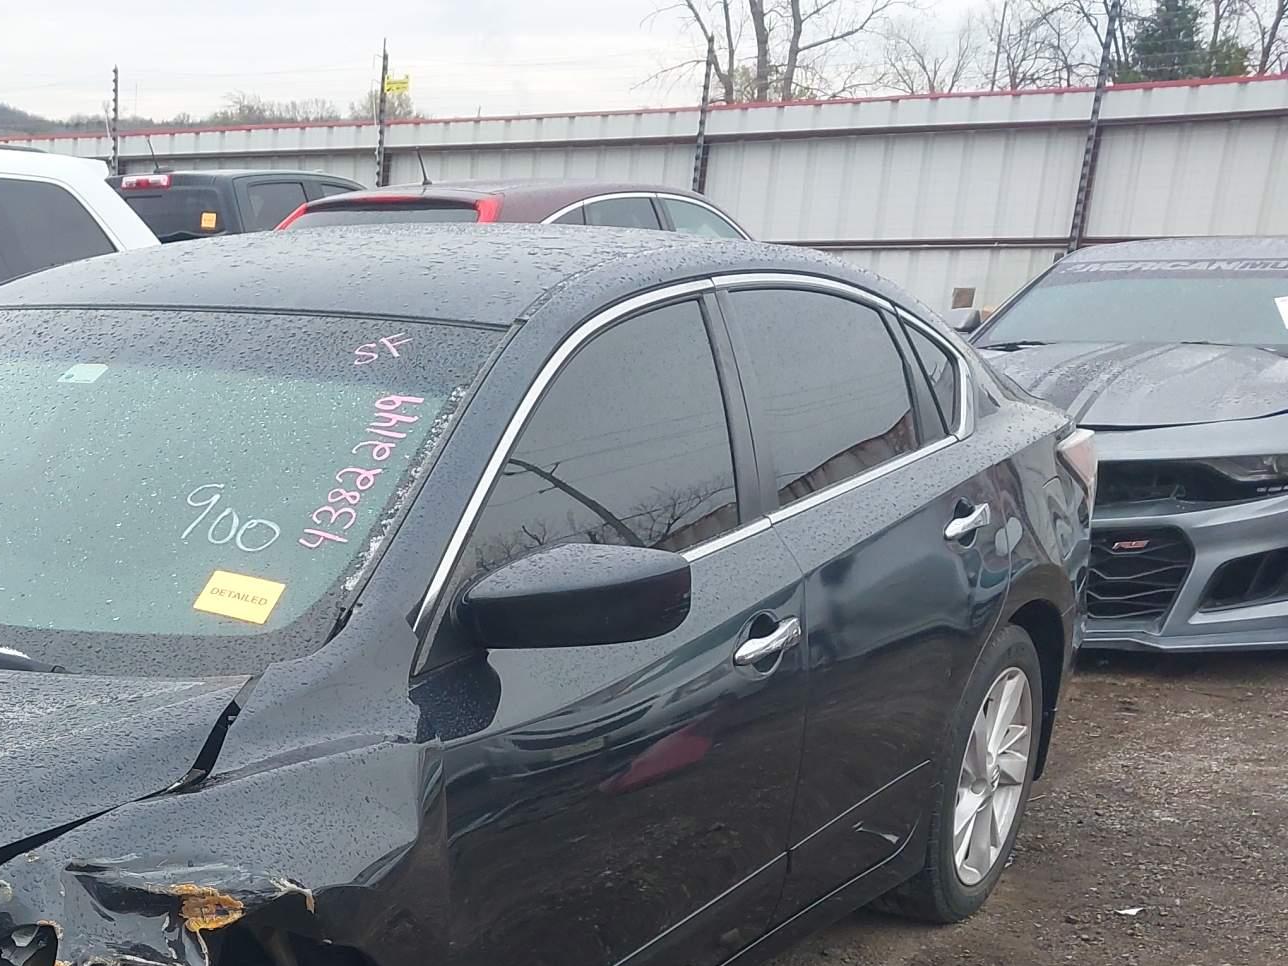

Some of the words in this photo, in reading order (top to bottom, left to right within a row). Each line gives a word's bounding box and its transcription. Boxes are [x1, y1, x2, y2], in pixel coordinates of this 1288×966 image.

[299, 394, 424, 548] 43822149
[181, 482, 281, 551] 900
[210, 587, 268, 606] DETAILED
